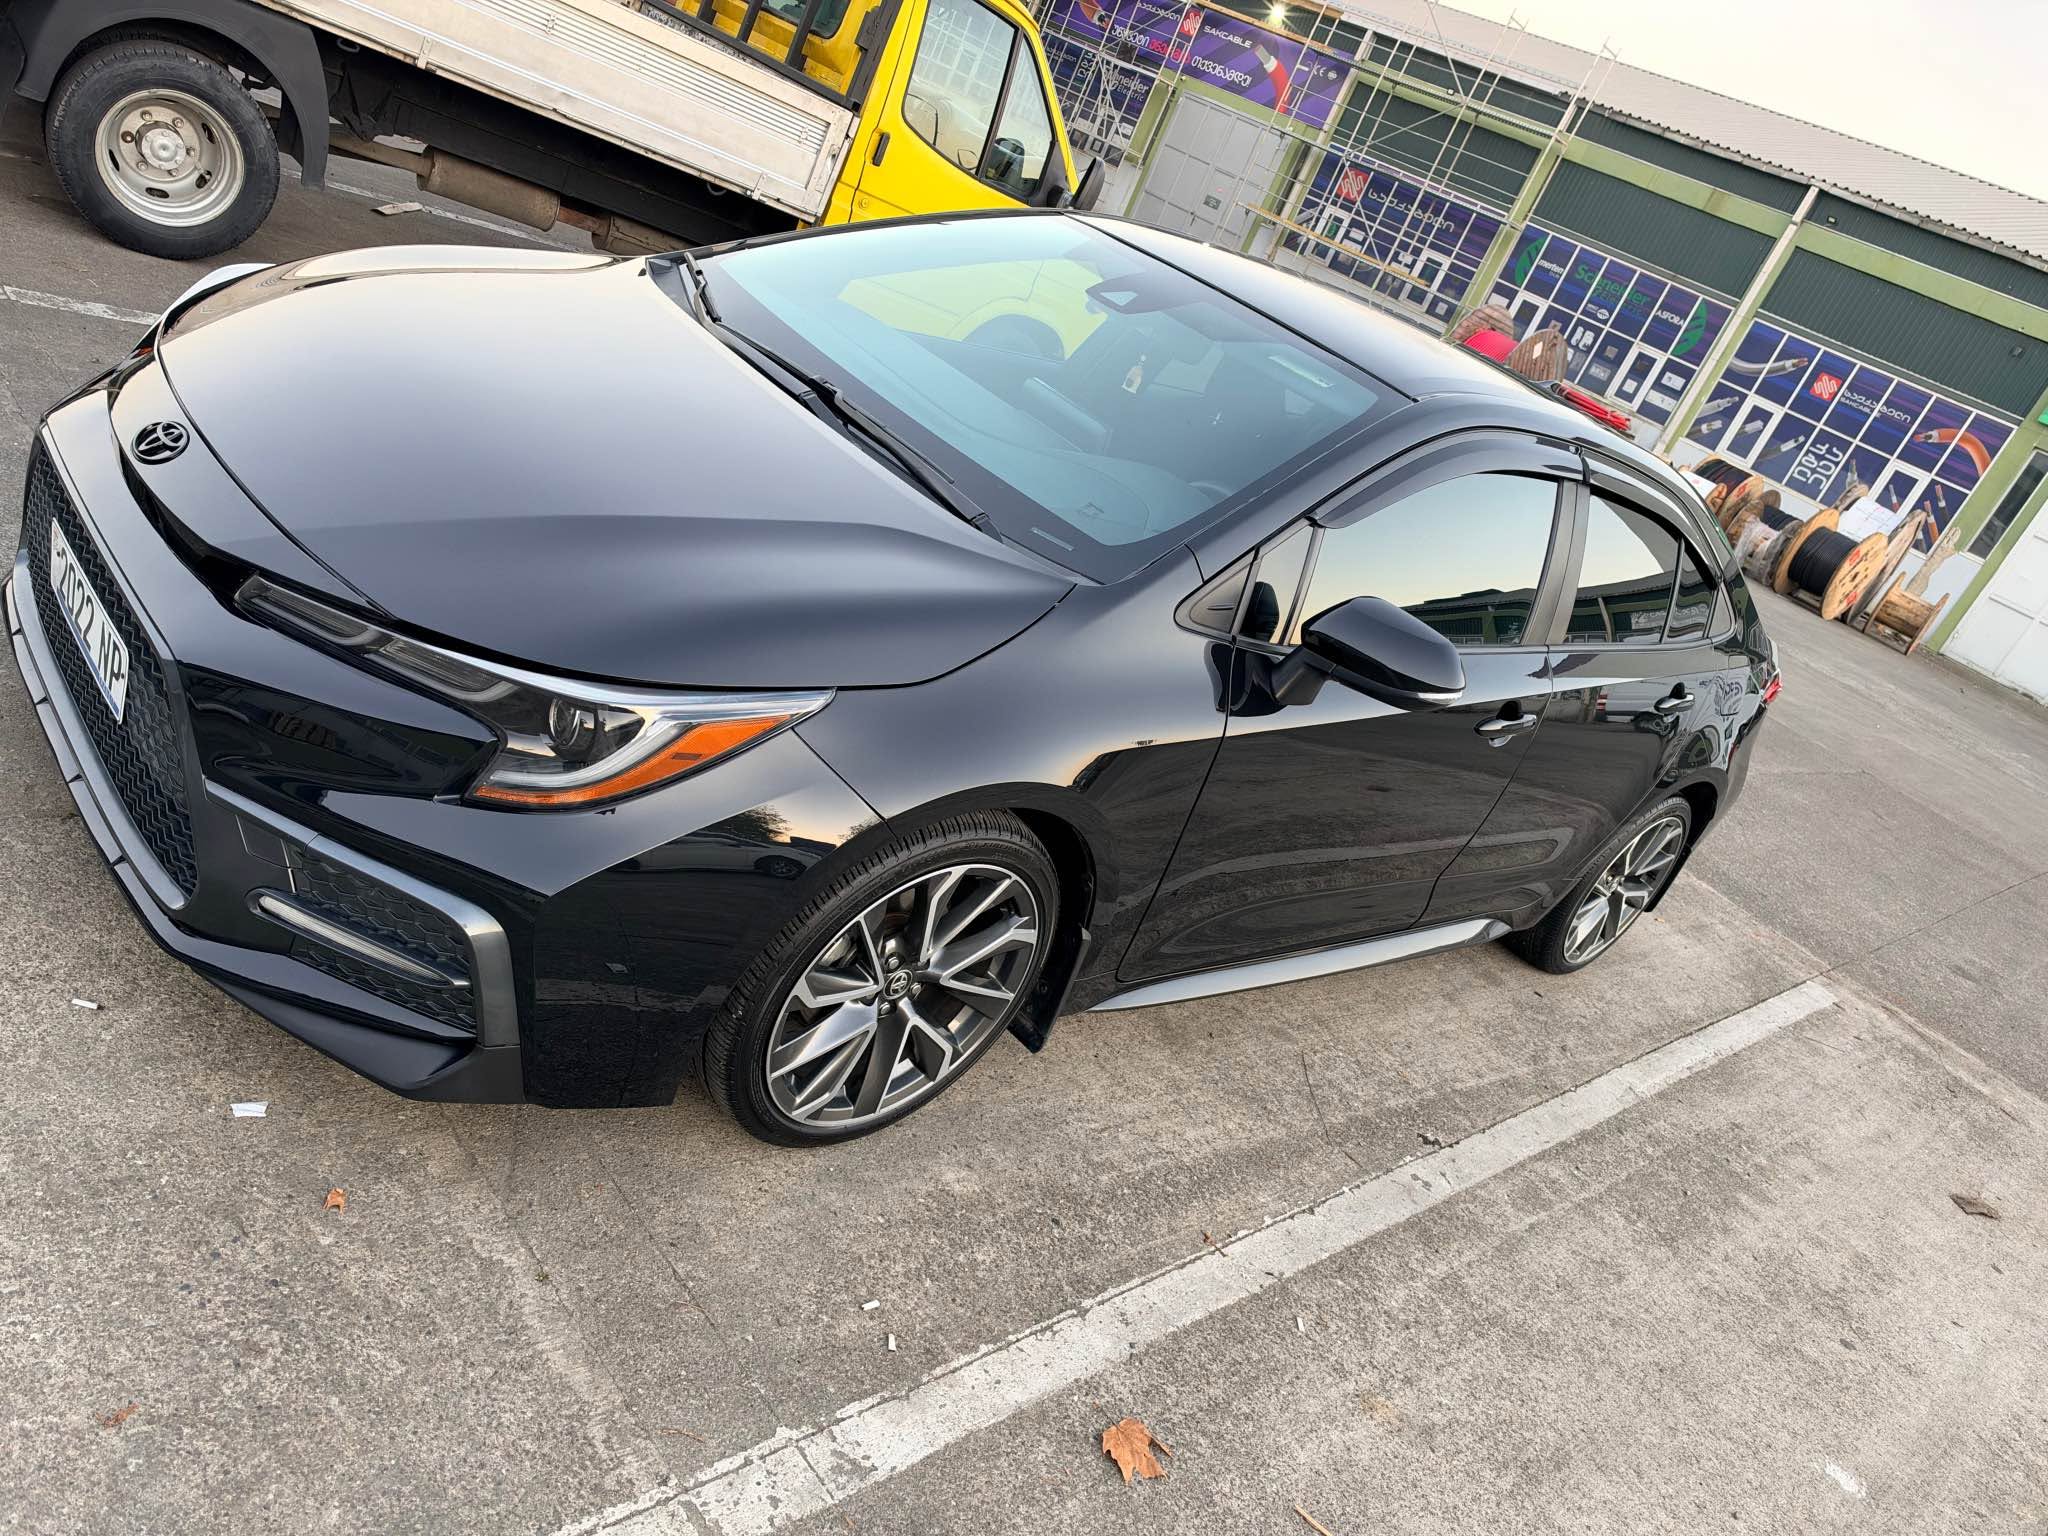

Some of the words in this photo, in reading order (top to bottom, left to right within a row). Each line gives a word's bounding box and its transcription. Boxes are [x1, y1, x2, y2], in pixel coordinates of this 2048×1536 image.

[1203, 25, 1253, 48] SAKCABLE
[1655, 309, 1685, 327] ASFORA
[58, 547, 95, 653] 2022
[98, 621, 123, 692] NP
